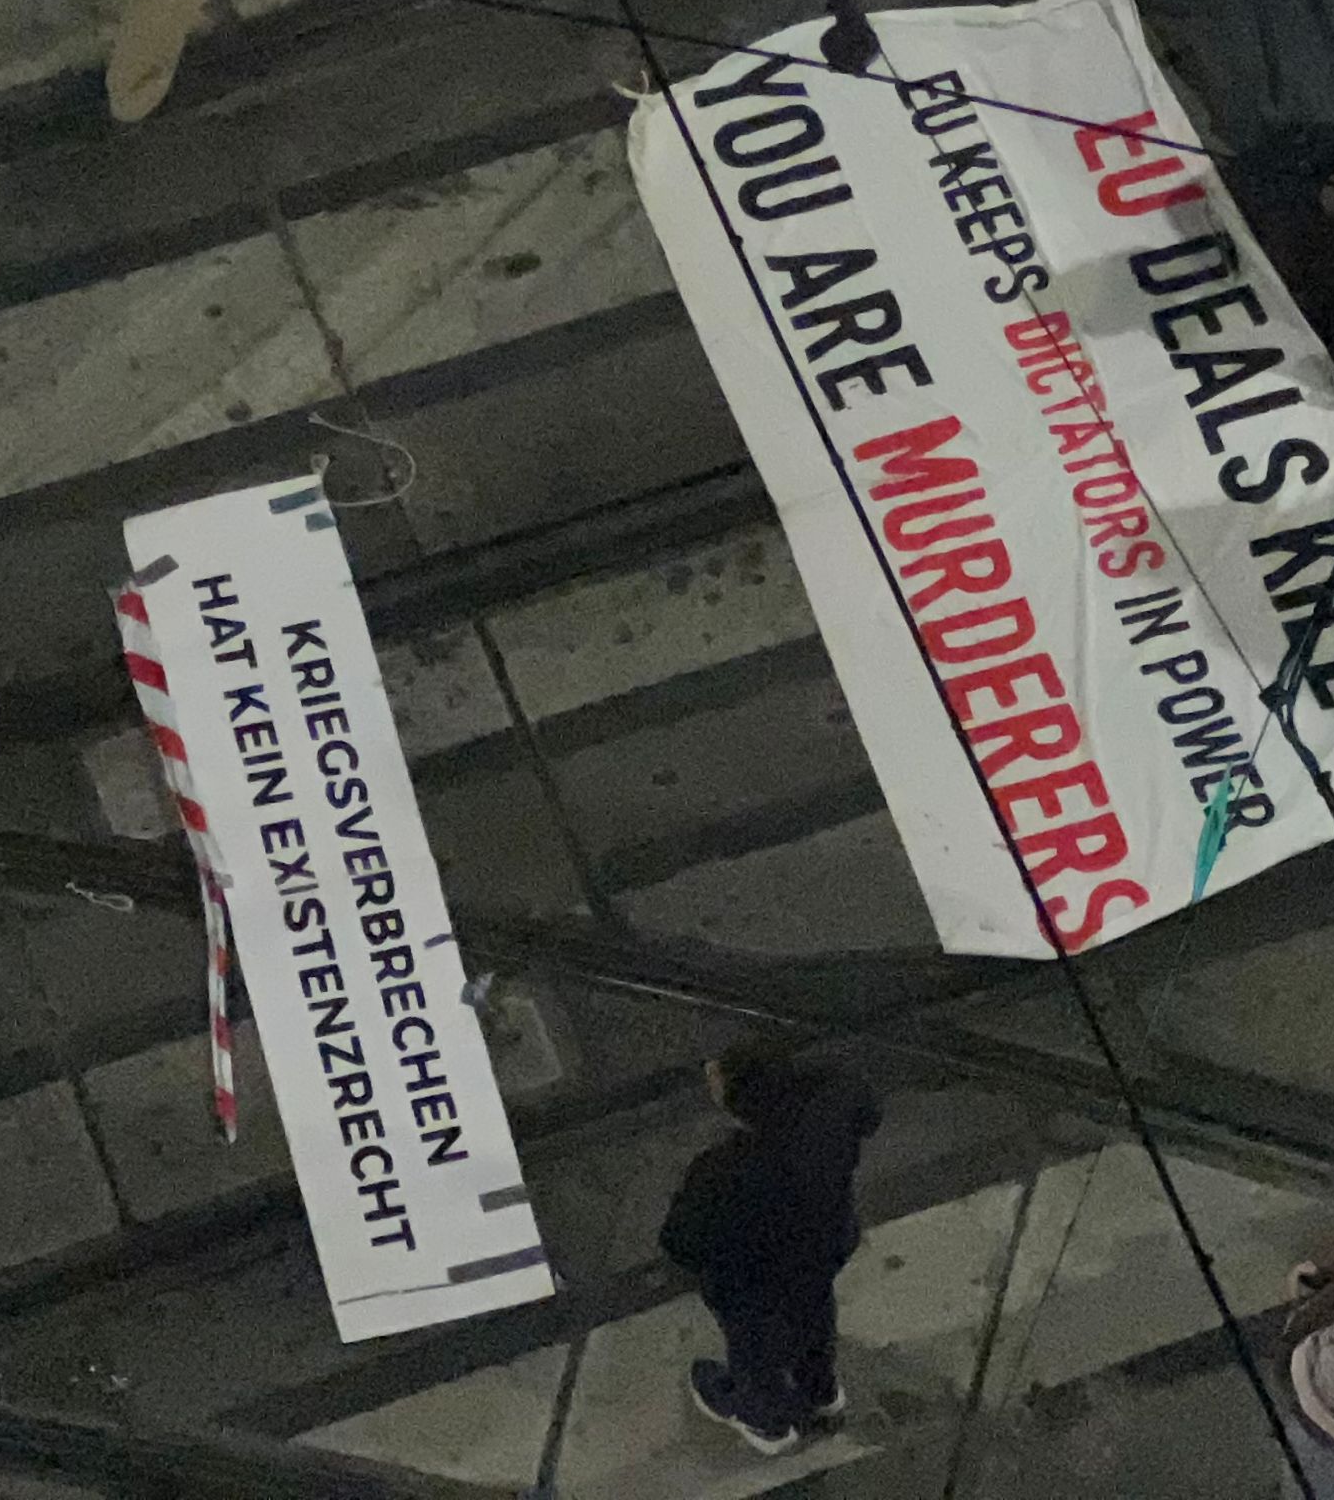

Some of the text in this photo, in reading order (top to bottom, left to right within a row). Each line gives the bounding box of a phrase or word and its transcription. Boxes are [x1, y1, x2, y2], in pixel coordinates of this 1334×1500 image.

[894, 69, 1276, 853] EU KEEPS DICTATORS IN POWER
[1071, 109, 1207, 218] EU
[1127, 232, 1331, 505] DEALS
[692, 45, 1151, 956] YOU ARE MURDERERS
[191, 572, 417, 1253] HAT KEIN EXISTENZRECHT
[280, 618, 470, 1167] KRIEGSVERBRECHEN
